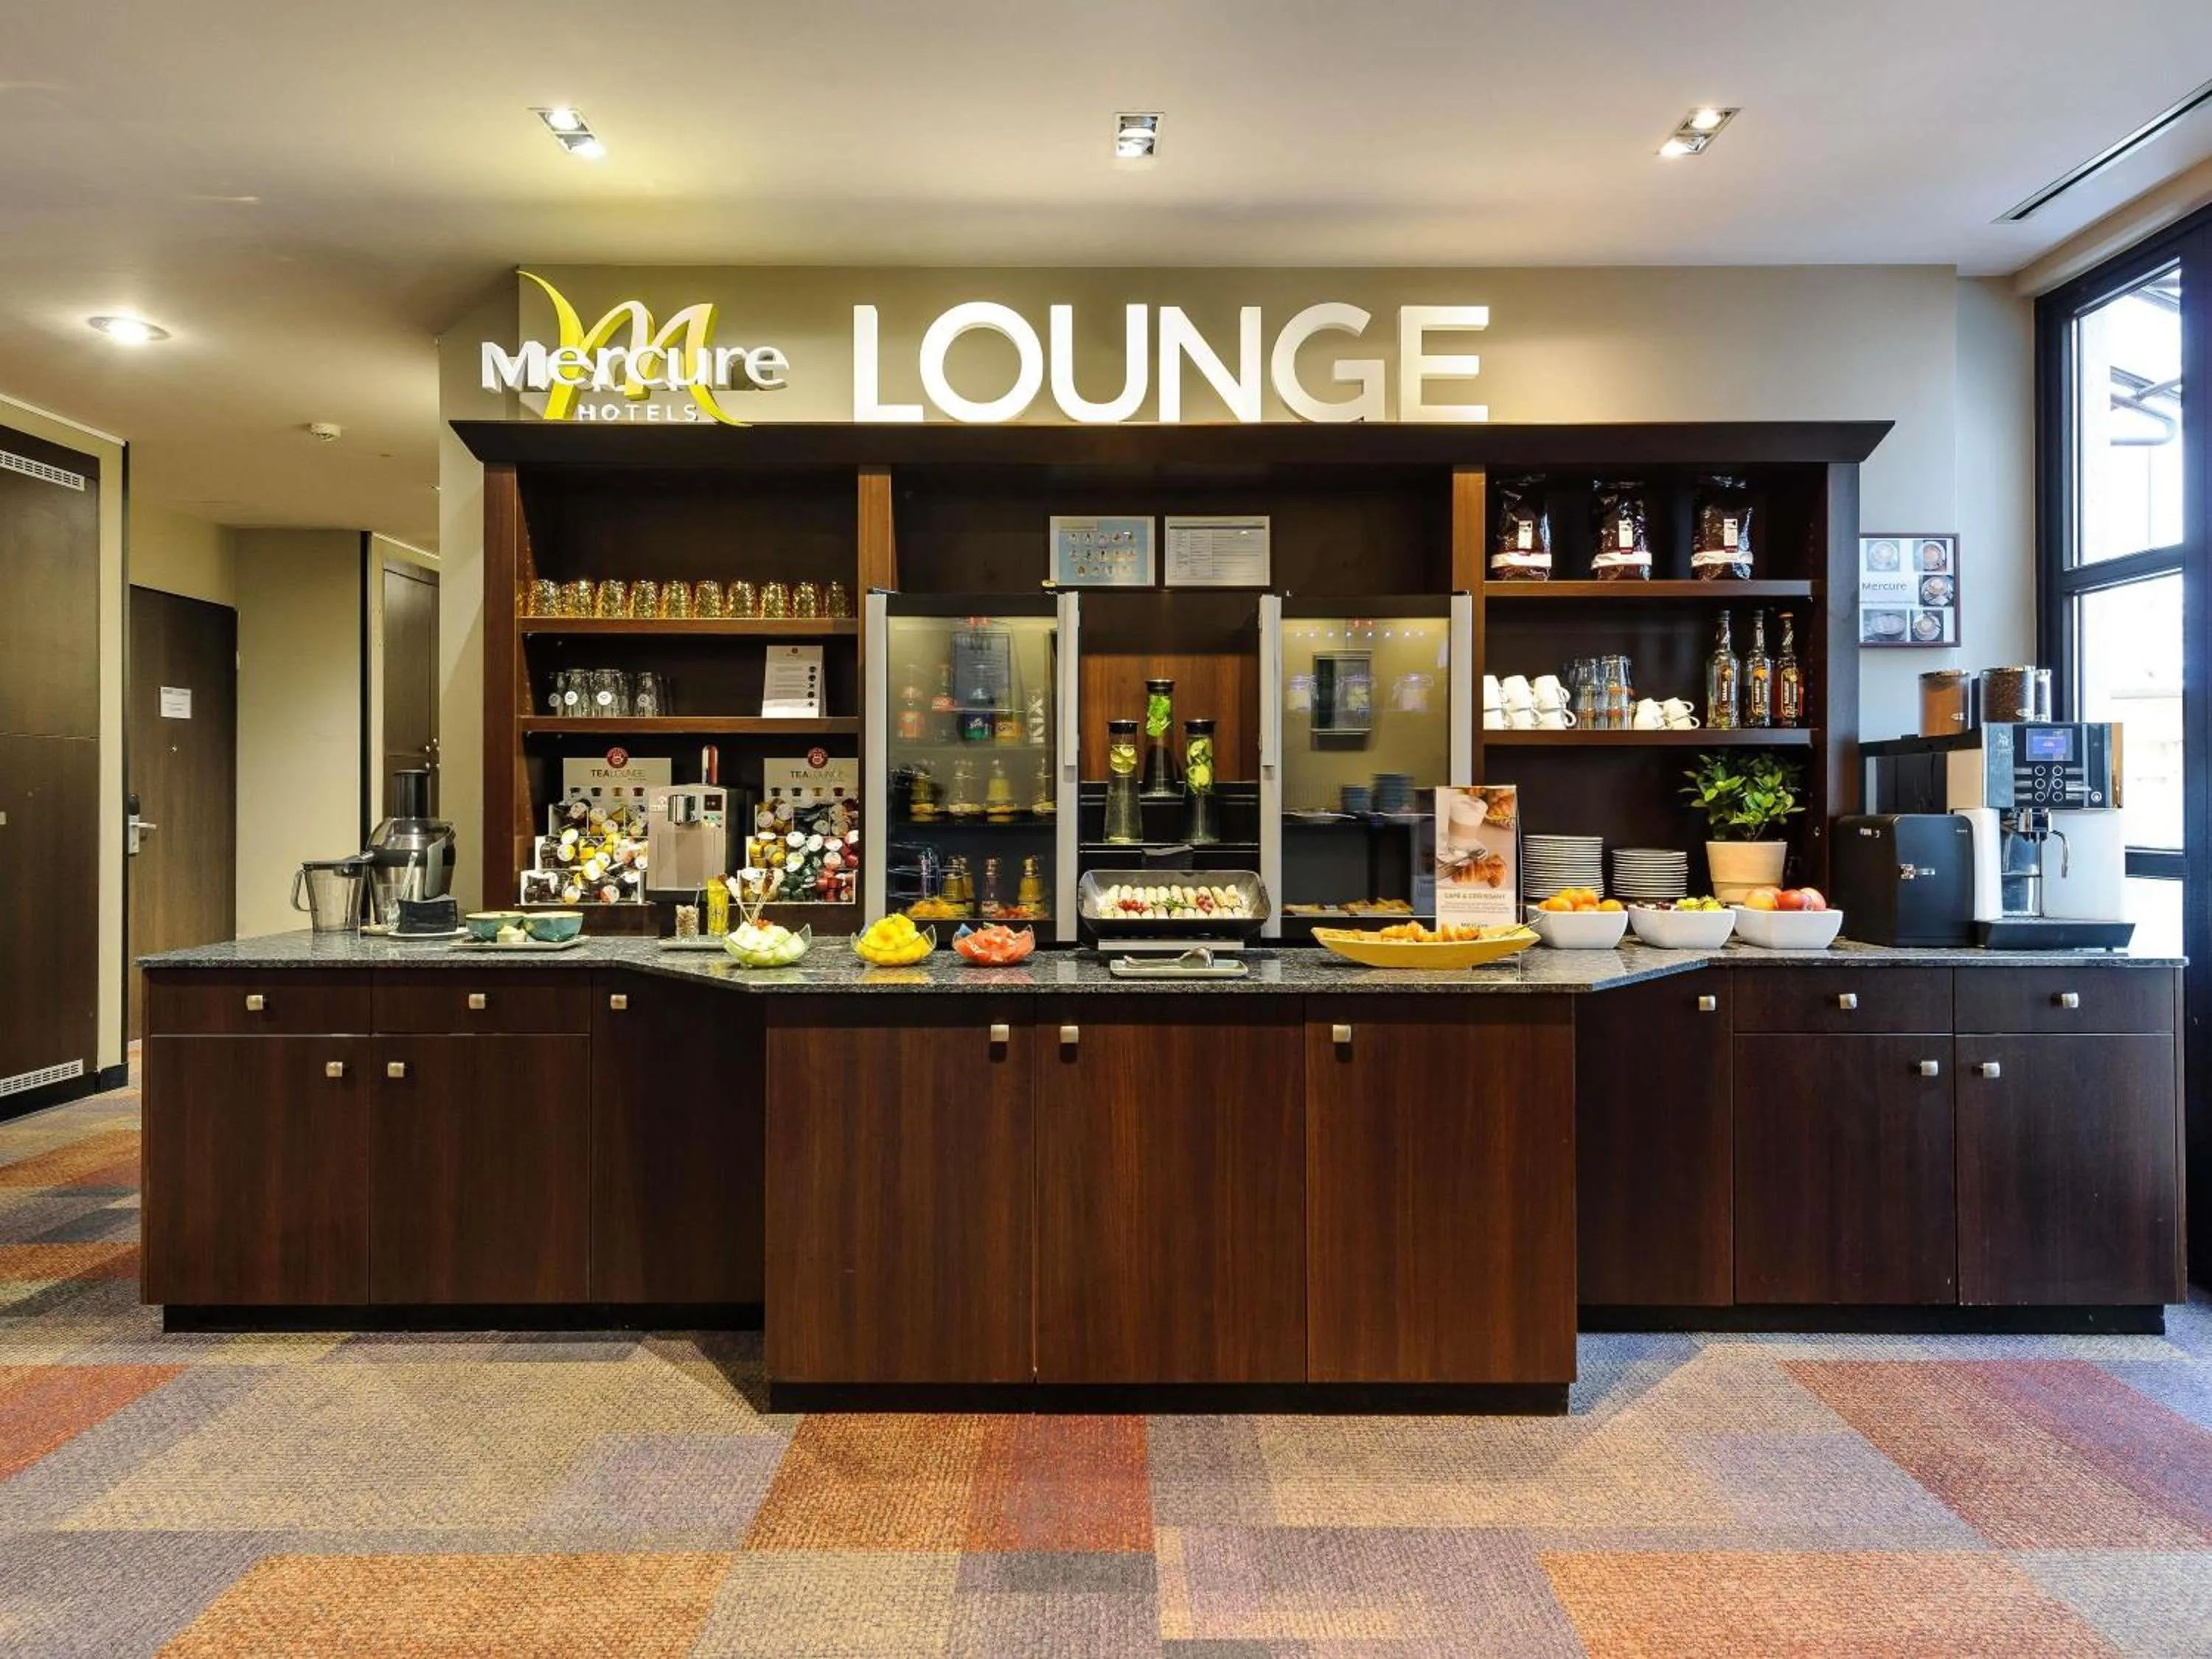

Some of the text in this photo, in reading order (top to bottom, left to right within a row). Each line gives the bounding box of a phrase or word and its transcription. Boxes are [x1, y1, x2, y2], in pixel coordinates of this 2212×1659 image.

[481, 341, 790, 393] Mercure
[853, 301, 1489, 424] LOUNGE
[578, 403, 699, 422] HOTELS
[1862, 582, 1907, 591] Mercure
